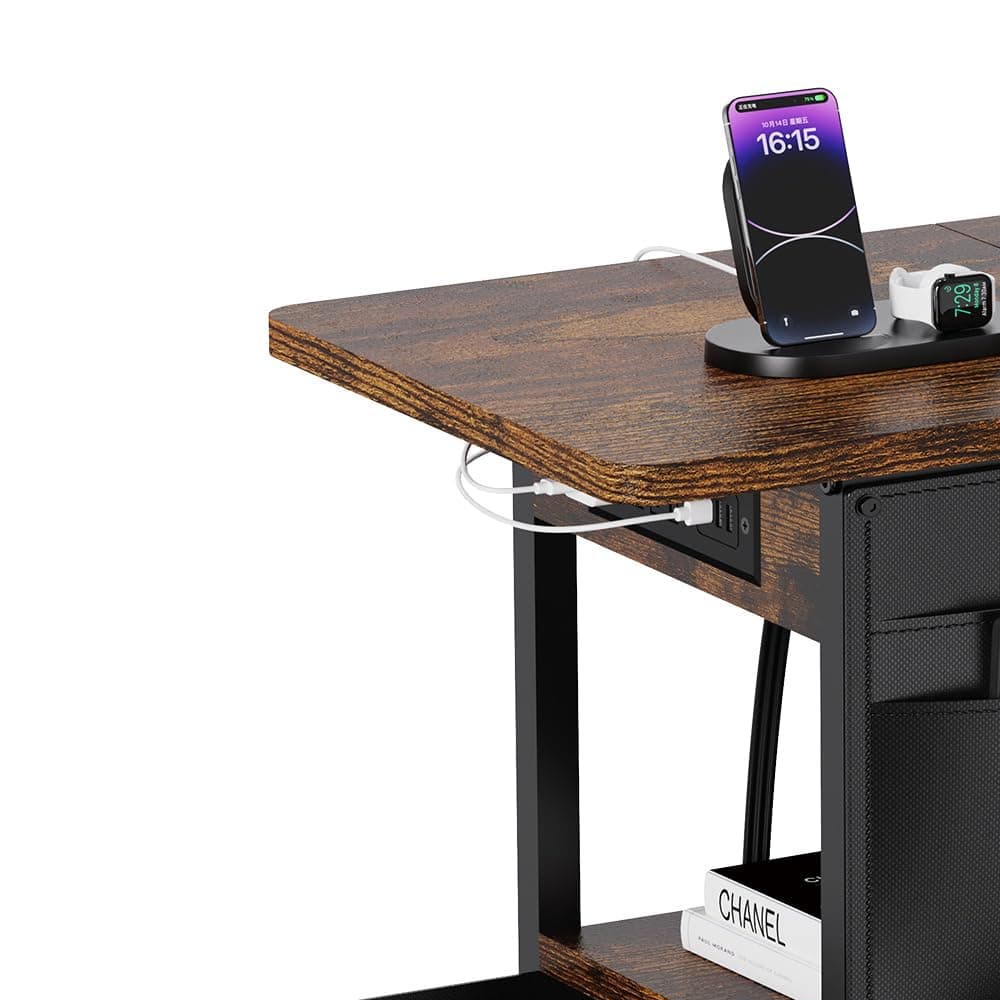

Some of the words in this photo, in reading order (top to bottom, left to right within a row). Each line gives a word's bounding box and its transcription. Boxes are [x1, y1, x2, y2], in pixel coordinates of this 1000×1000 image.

[761, 118, 788, 128] 10月14日
[756, 127, 820, 156] 16:15
[954, 283, 971, 317] 7:29
[718, 888, 786, 947] CHANEL
